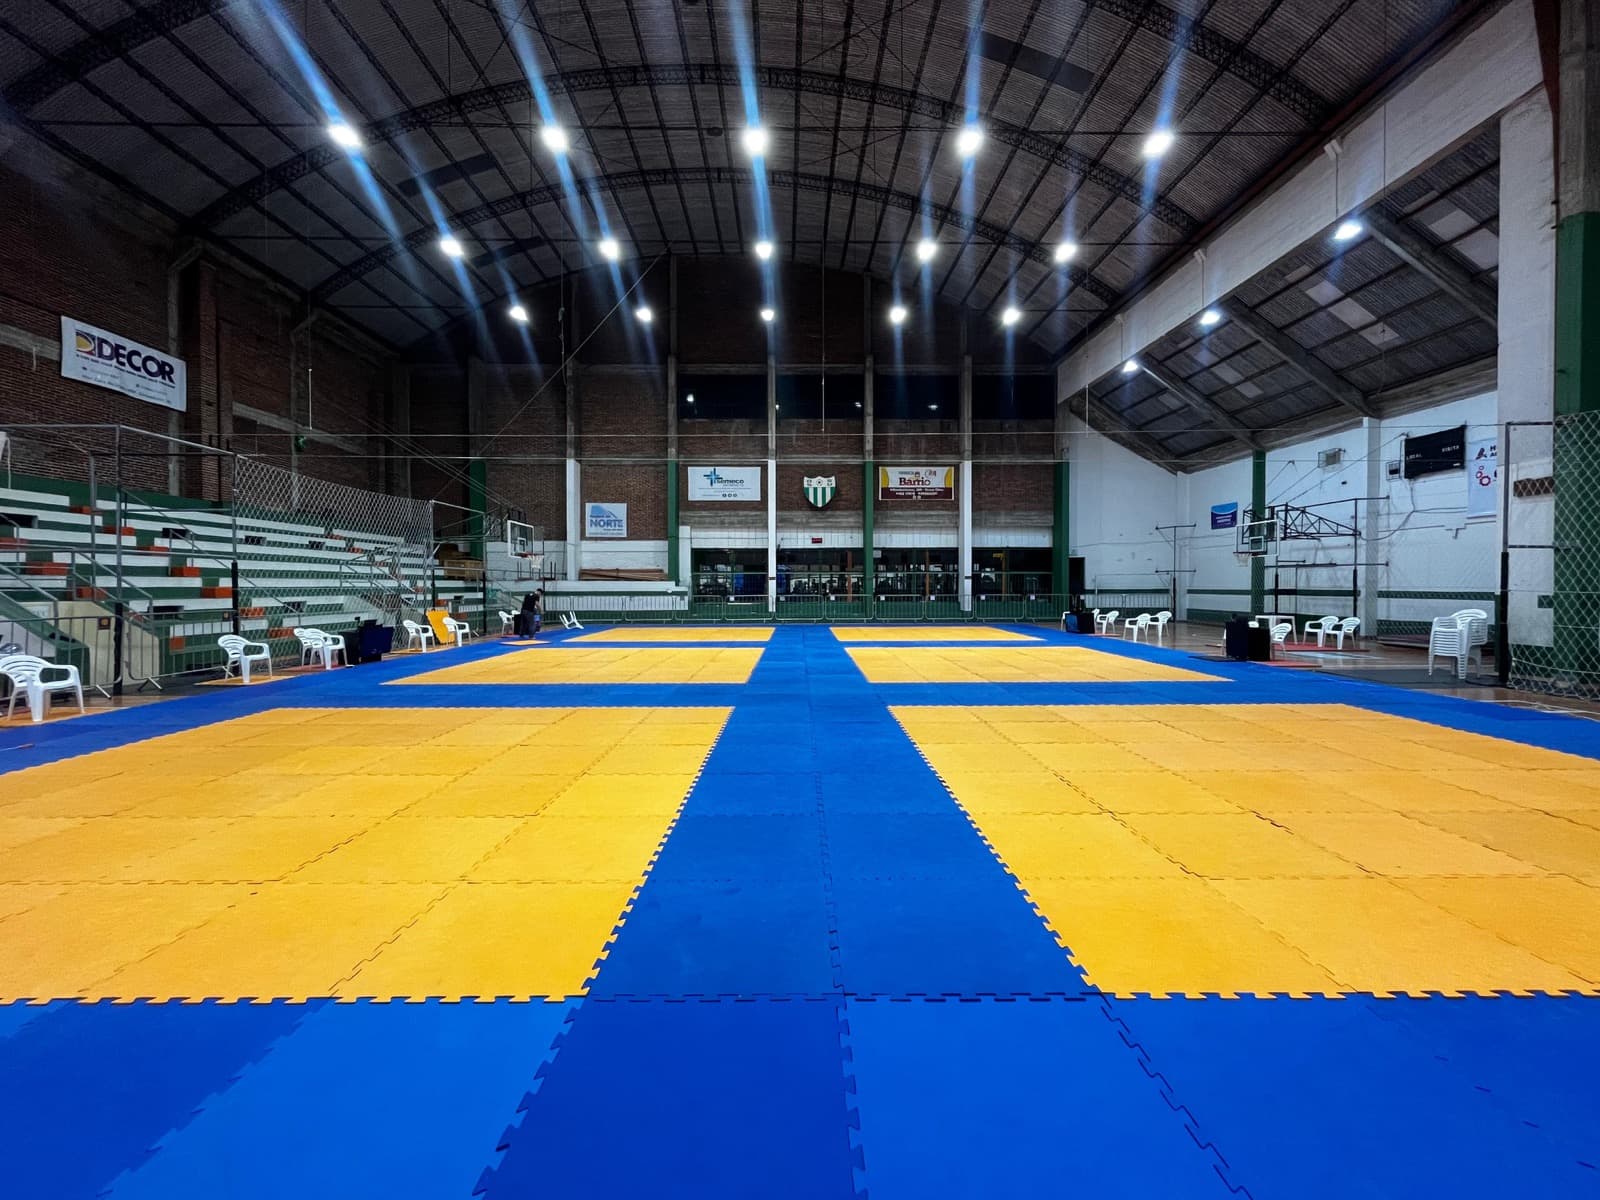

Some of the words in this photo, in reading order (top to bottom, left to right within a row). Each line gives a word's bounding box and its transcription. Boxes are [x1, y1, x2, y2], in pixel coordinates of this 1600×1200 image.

[97, 336, 175, 384] DECOR
[898, 476, 931, 486] Barrio
[590, 519, 624, 528] NORTE
